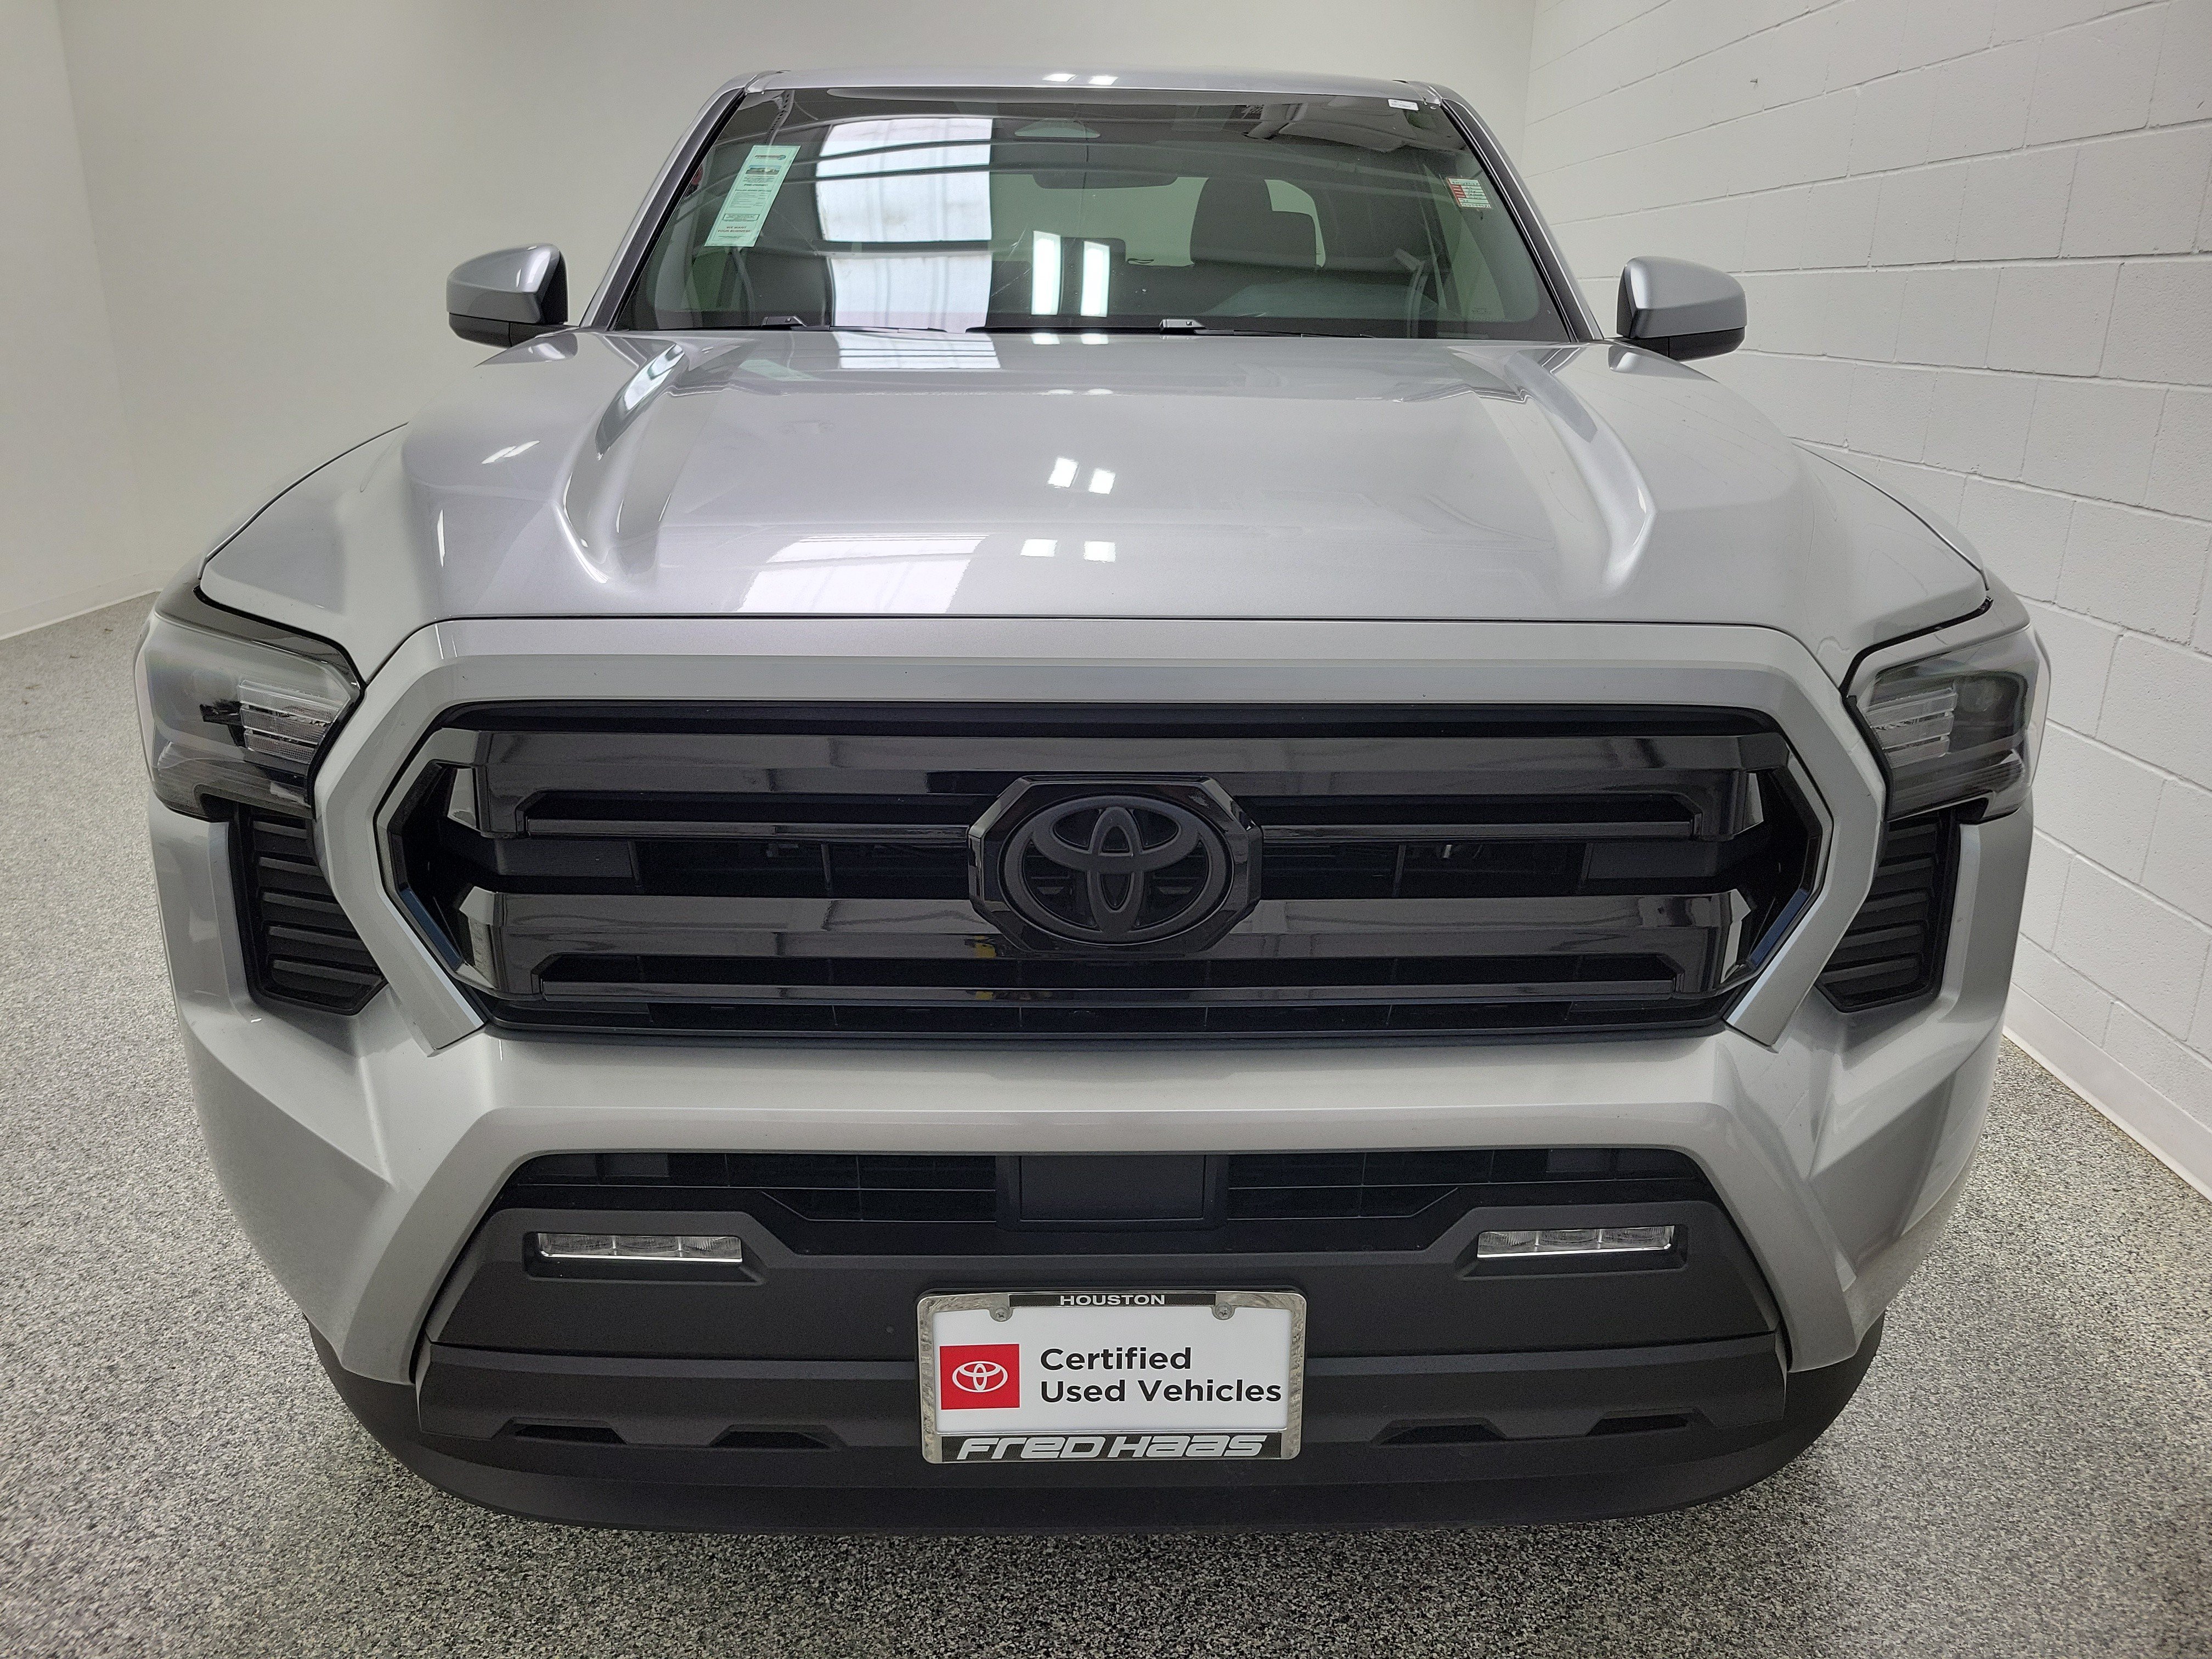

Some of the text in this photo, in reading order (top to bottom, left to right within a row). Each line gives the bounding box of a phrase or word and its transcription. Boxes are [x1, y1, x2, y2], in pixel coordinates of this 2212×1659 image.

[1060, 1294, 1166, 1306] HOUSTON
[1041, 1347, 1192, 1370] Certified
[1041, 1379, 1282, 1403] Used Vehicles
